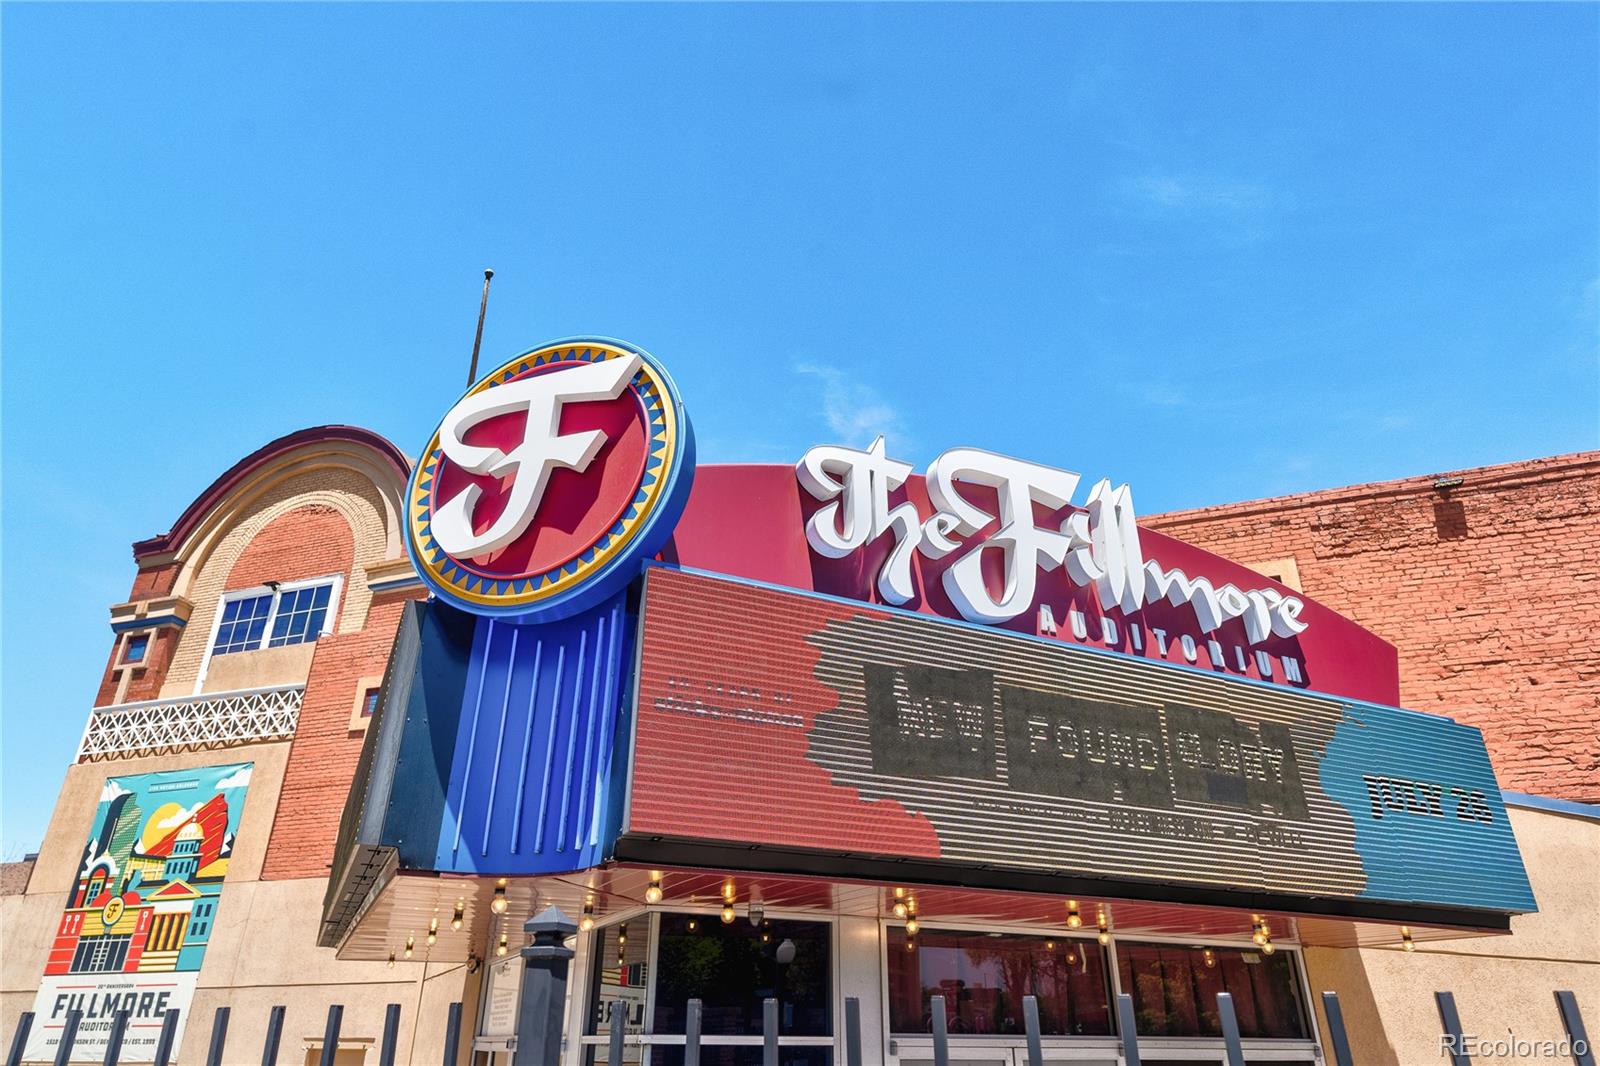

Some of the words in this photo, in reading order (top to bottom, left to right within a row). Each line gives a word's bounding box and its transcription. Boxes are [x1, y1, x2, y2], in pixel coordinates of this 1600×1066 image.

[430, 353, 643, 559] F
[926, 446, 1310, 646] Fillmore
[1039, 603, 1302, 684] AUDITORIUM
[1028, 715, 1159, 774] FOUND
[1362, 774, 1445, 820] JULY
[51, 991, 171, 1019] FILLMORE
